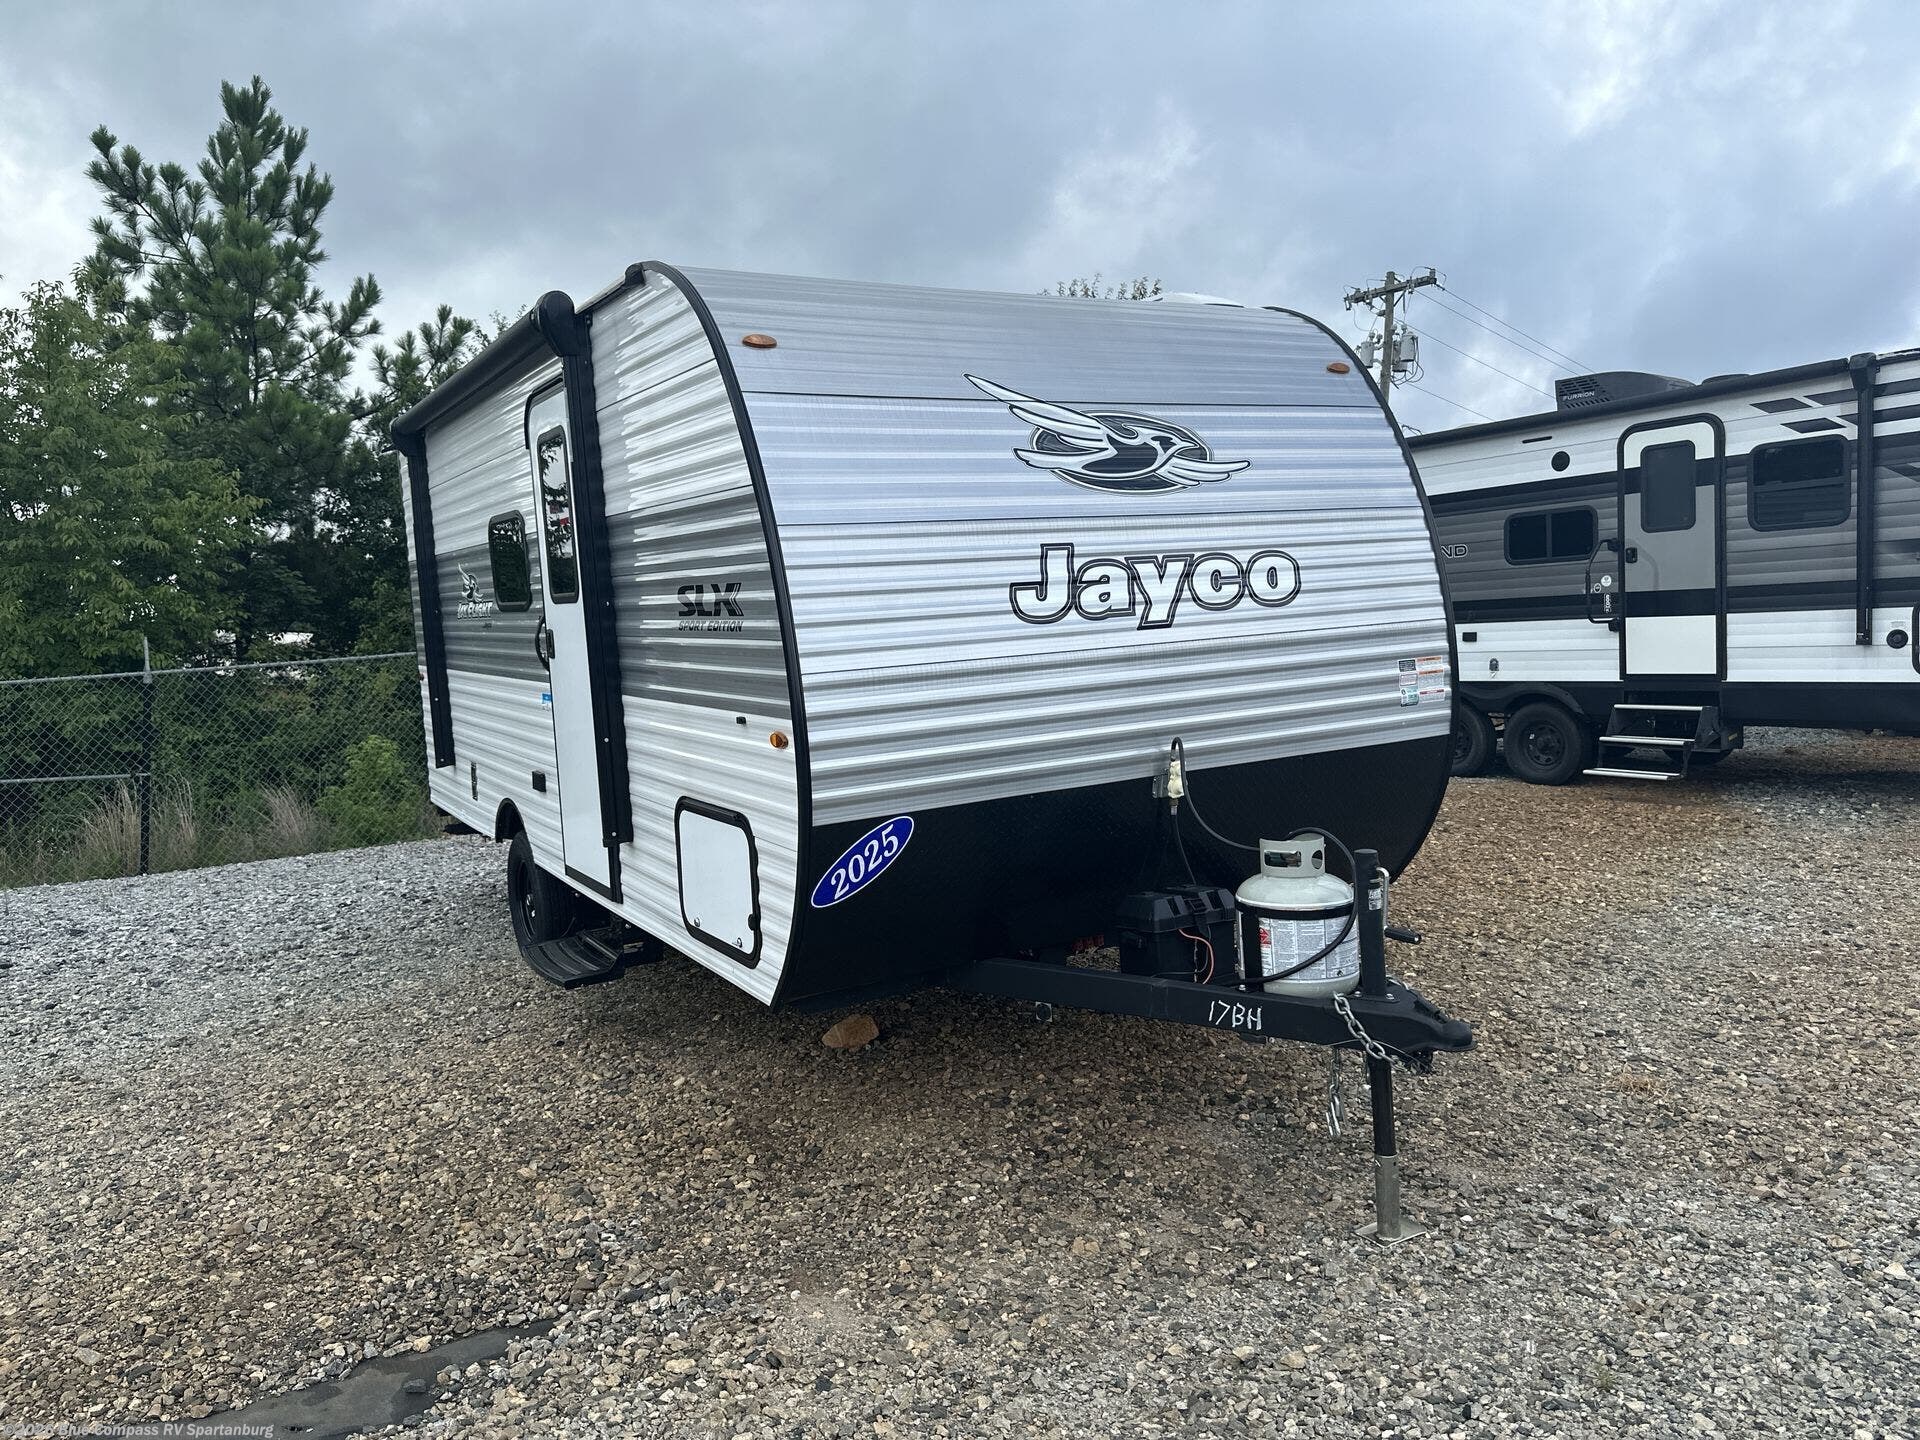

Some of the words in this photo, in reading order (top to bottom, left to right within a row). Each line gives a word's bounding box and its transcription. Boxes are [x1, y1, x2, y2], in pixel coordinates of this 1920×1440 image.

[677, 583, 744, 616] SLX
[1009, 543, 1302, 630] Jayco
[468, 601, 493, 618] FLIGHT
[678, 620, 704, 632] SPORT
[706, 620, 744, 632] EDITION
[830, 823, 899, 900] 2025
[1208, 1000, 1263, 1030] 17BH
